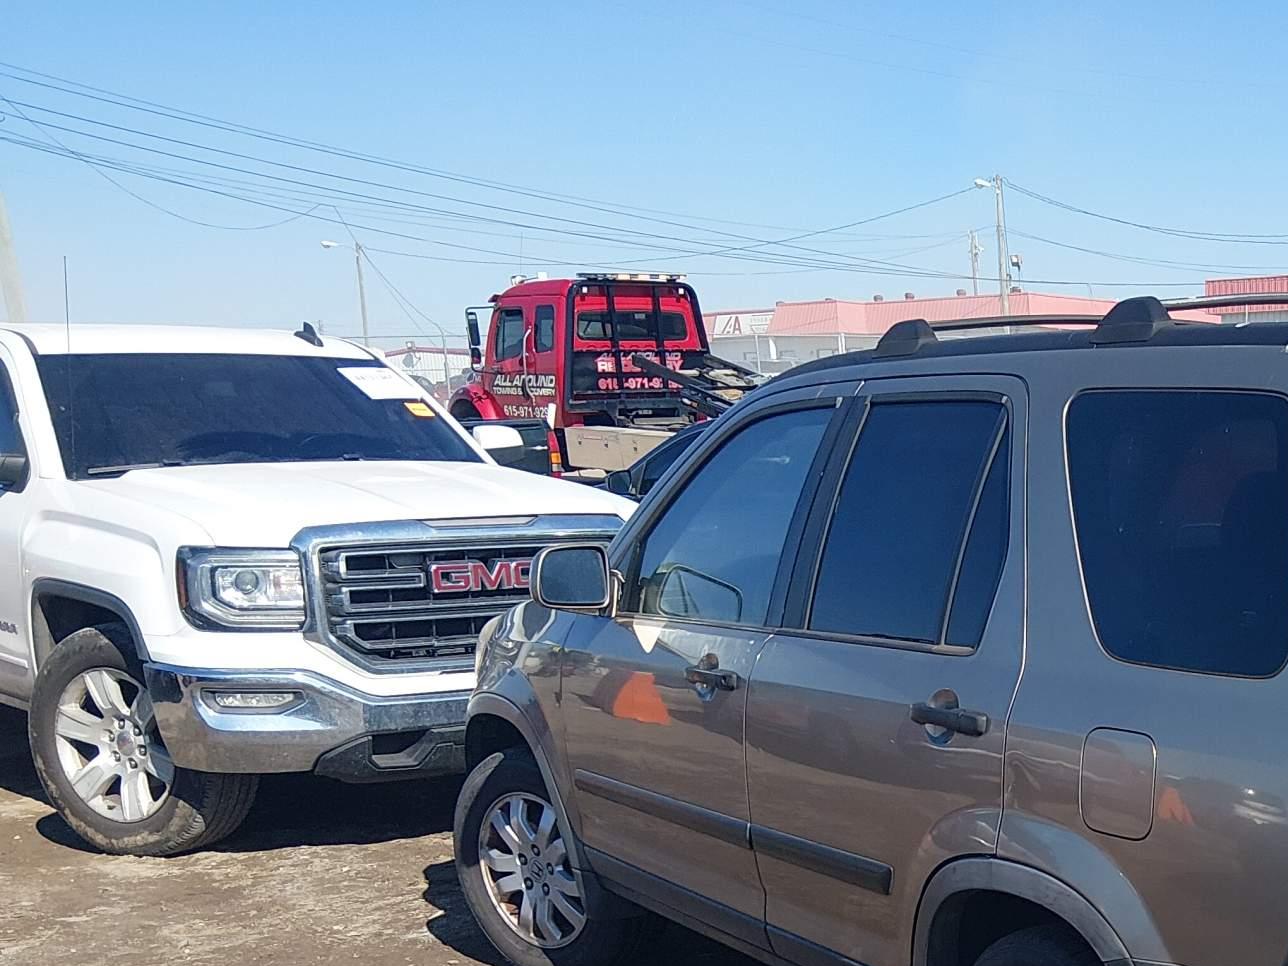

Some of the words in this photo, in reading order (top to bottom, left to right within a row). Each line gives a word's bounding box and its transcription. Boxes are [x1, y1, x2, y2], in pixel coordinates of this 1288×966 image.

[494, 375, 511, 386] ALL
[493, 387, 517, 395] TOWING
[432, 560, 532, 592] GMC
